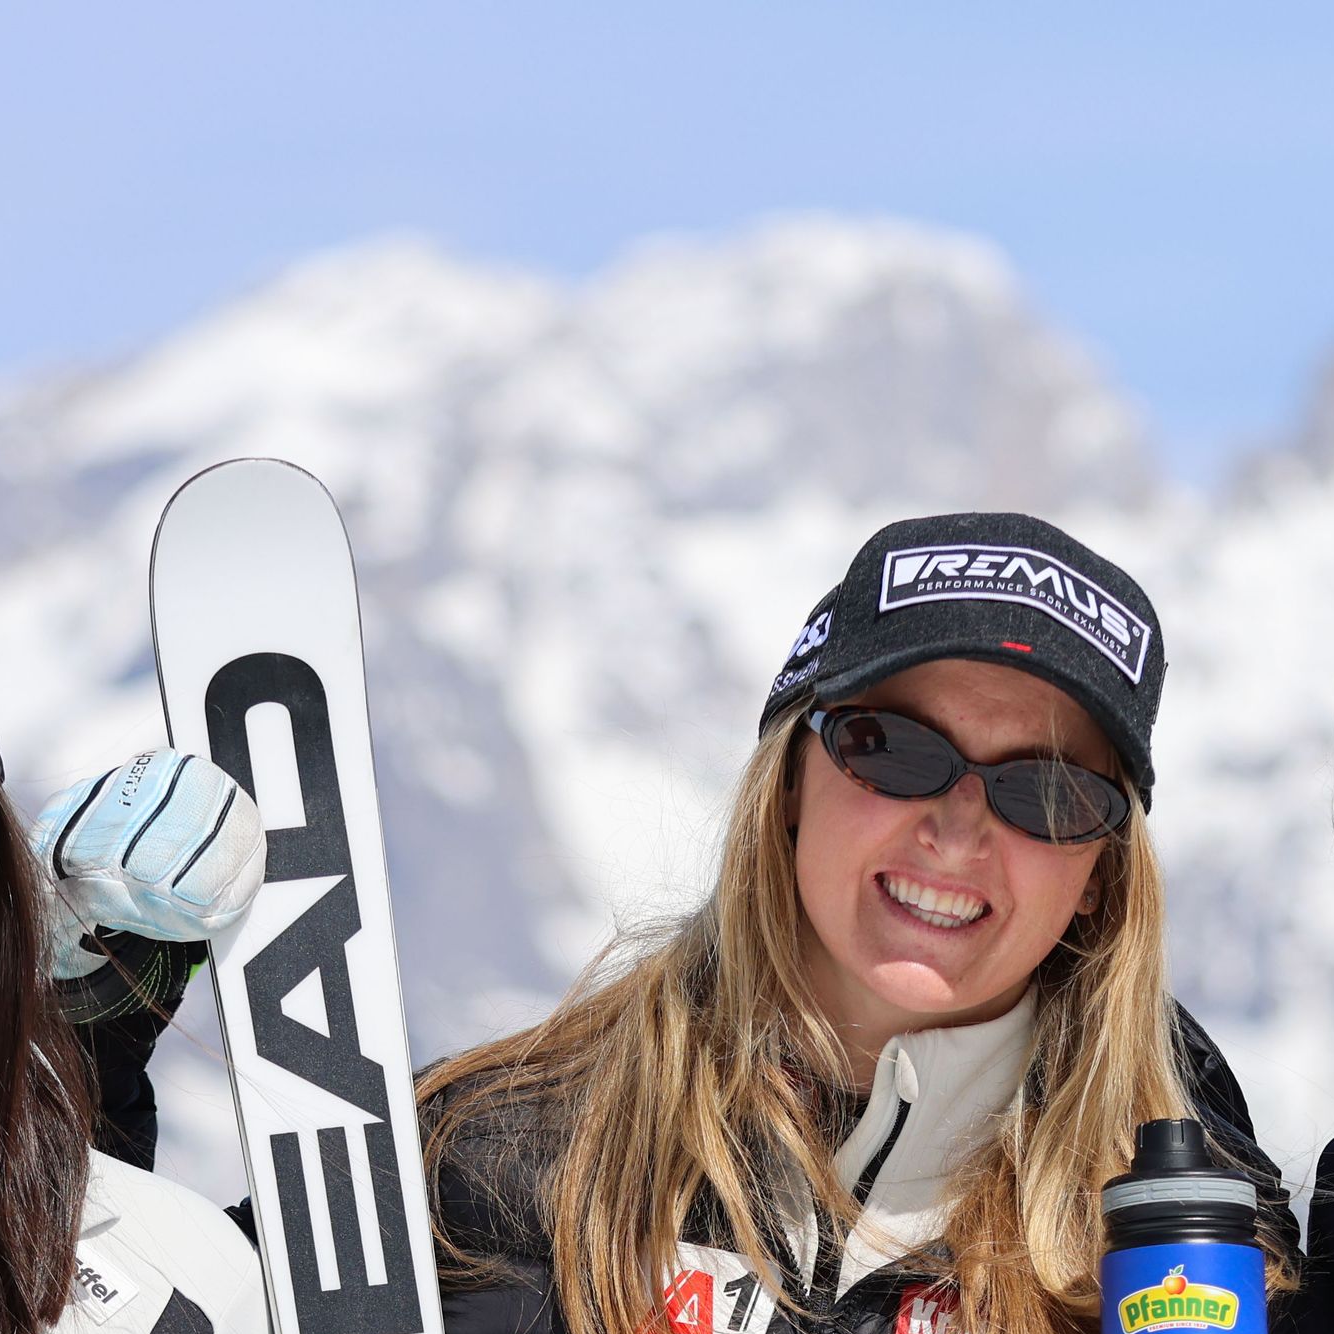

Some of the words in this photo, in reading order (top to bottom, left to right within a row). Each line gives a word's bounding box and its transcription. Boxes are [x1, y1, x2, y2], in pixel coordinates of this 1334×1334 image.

[918, 580, 1023, 592] PERFORMANCE
[1030, 588, 1068, 614] SPORT
[1074, 613, 1127, 660] EXHAUSTS
